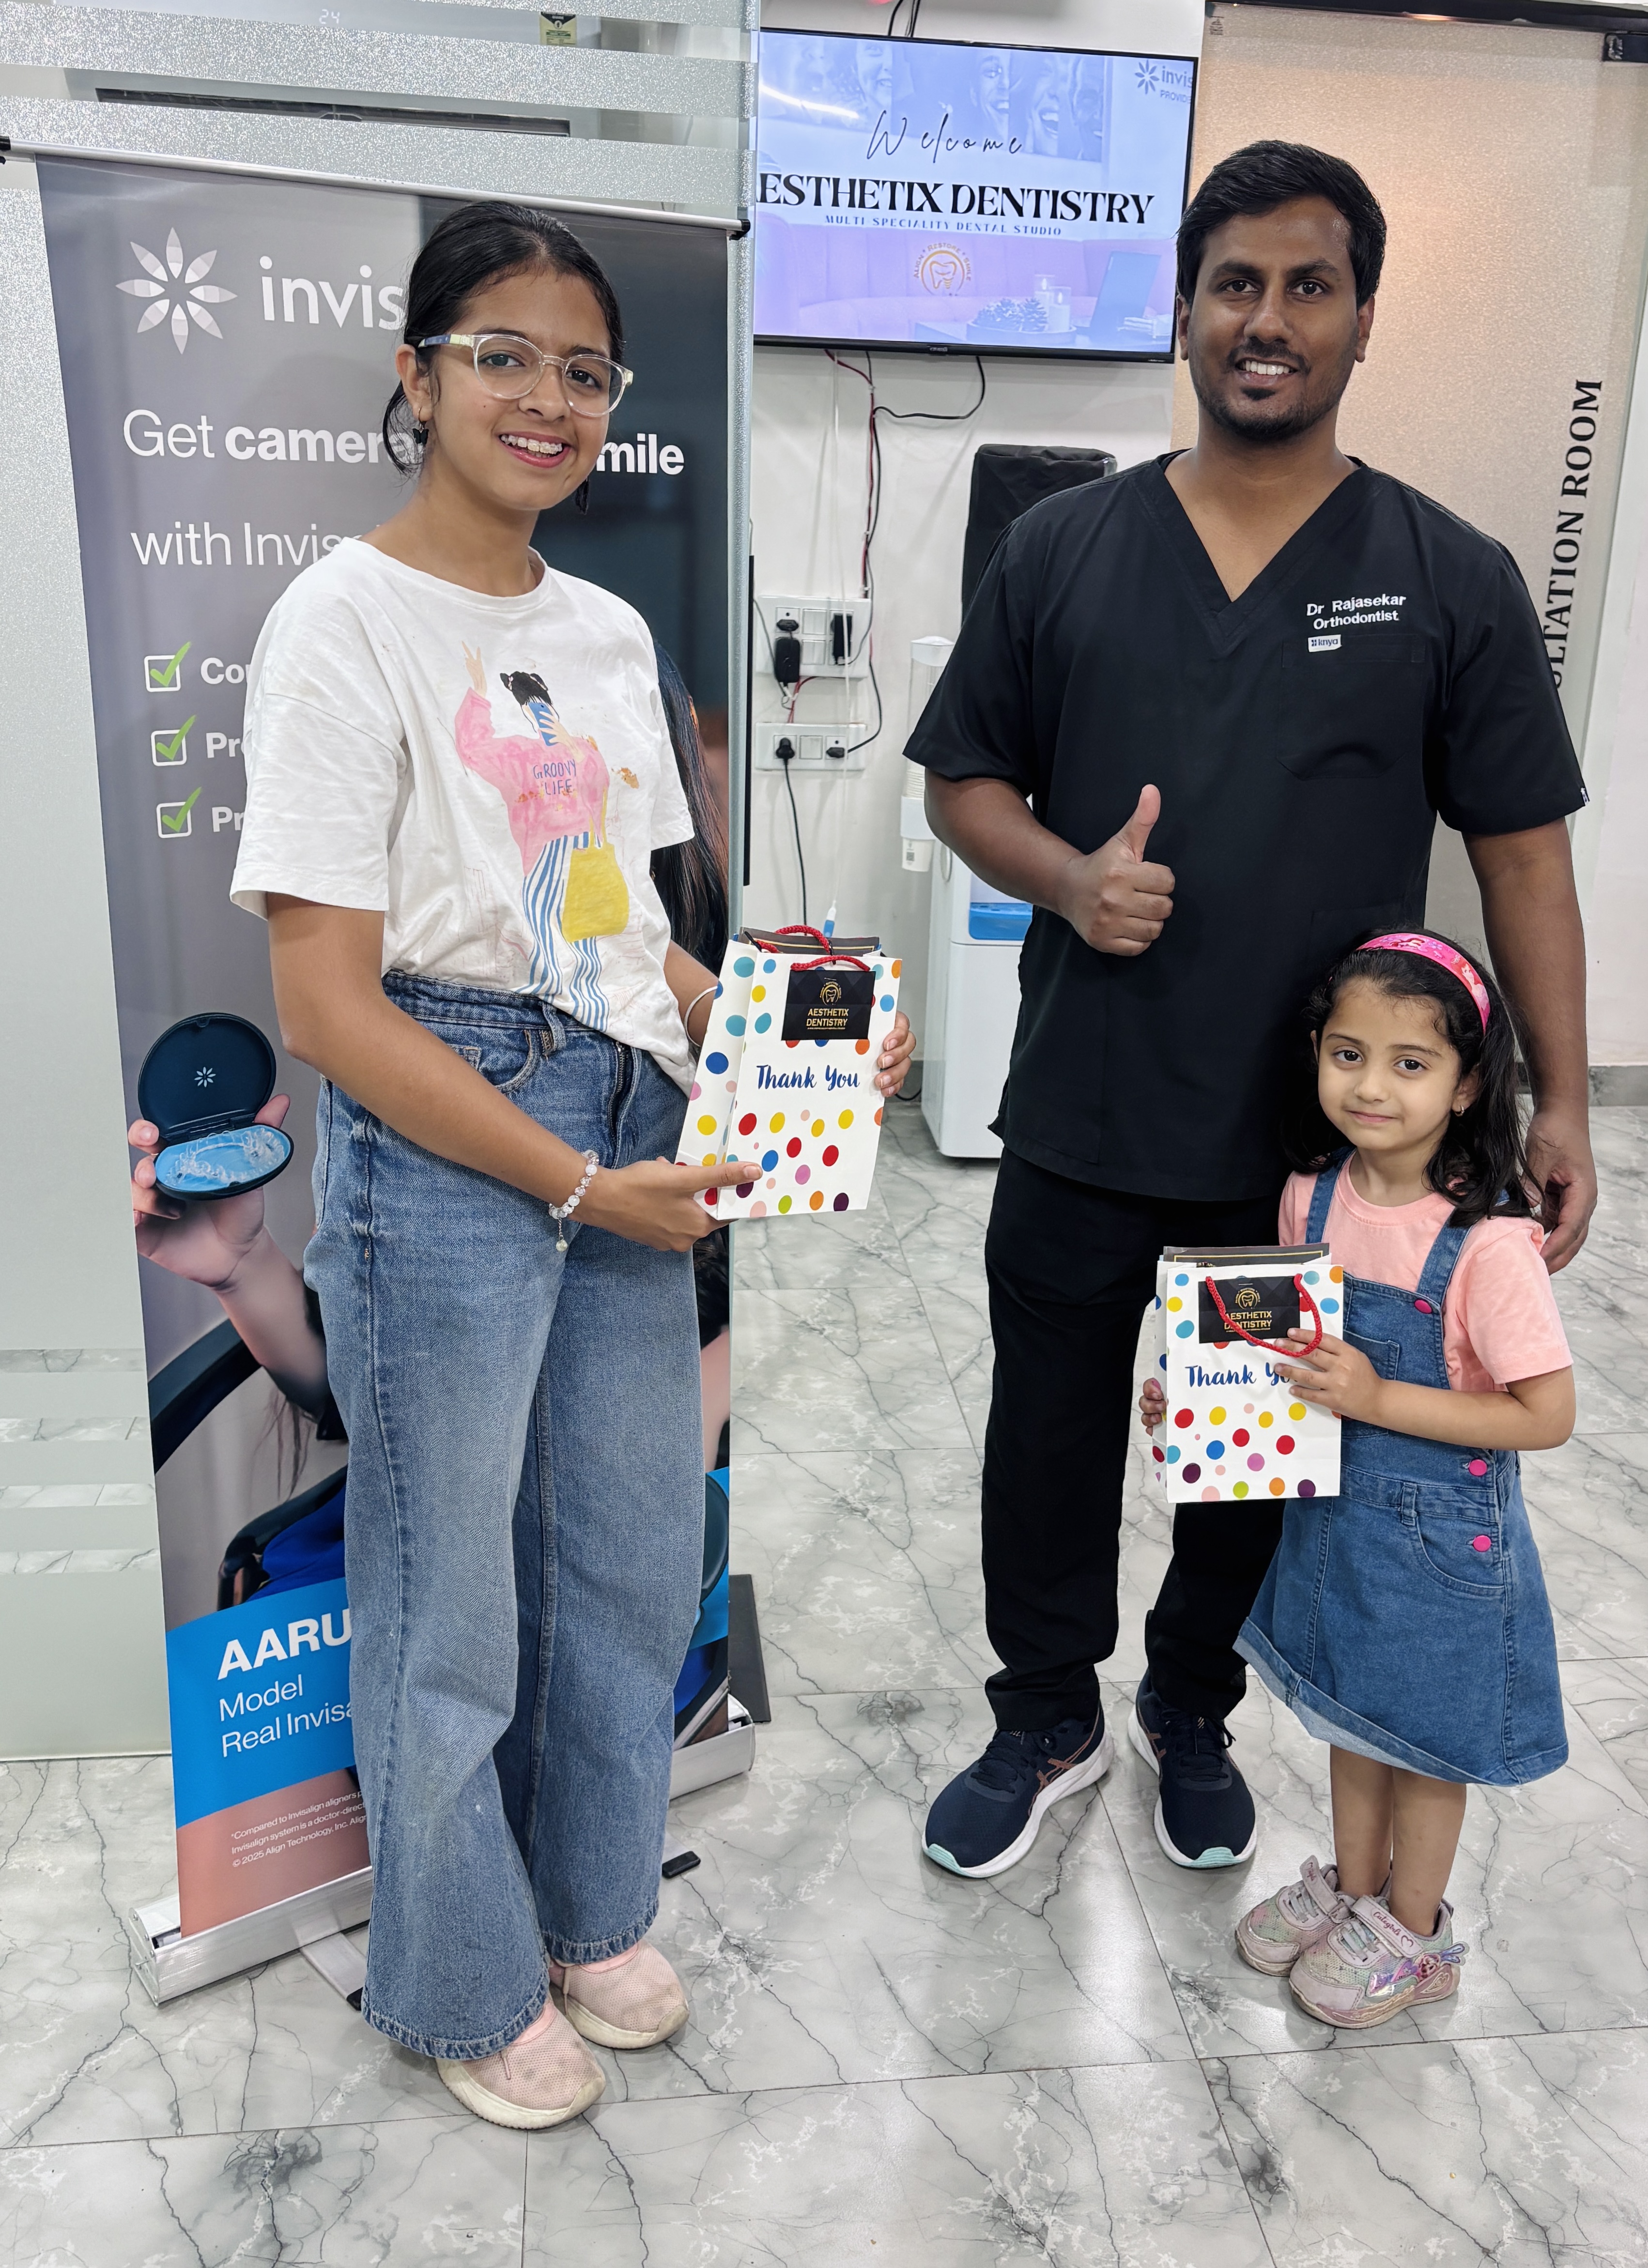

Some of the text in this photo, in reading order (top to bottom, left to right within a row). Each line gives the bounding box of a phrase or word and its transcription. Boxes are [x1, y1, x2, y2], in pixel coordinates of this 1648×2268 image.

[319, 9, 339, 24] 24
[867, 110, 1022, 163] Welcome
[756, 173, 1155, 223] ESTHETIX DENTISTRY
[826, 215, 1061, 235] MULTI SPECIALITY DENTAL STUDIO
[927, 243, 961, 253] RESTORE
[260, 256, 406, 330] invis
[123, 409, 215, 458] Get
[1561, 380, 1603, 498] ROOM
[131, 521, 231, 565] with
[1307, 594, 1406, 616] Dr Rajasekar
[1313, 610, 1399, 630] Orthodontist
[206, 732, 245, 758] Pr
[533, 759, 576, 779] GROOVY
[545, 779, 572, 795] LIFE
[806, 1018, 847, 1027] DENTISTRY
[808, 1008, 849, 1016] AESTHETIX
[756, 1064, 860, 1091] Thank You
[1224, 1319, 1272, 1330] DNTISTRY
[1185, 1364, 1257, 1387] Thank
[217, 1608, 352, 1681] AARU
[219, 1674, 303, 1721] Model
[222, 1717, 280, 1758] Real
[279, 1814, 287, 1824] to
[288, 1803, 324, 1820] Invisalign
[325, 1792, 357, 1808] aligners
[232, 1836, 269, 1854] Invisalign
[270, 1825, 299, 1840] system
[300, 1820, 307, 1829] is
[242, 1850, 264, 1865] 2025
[265, 1843, 285, 1855] Align
